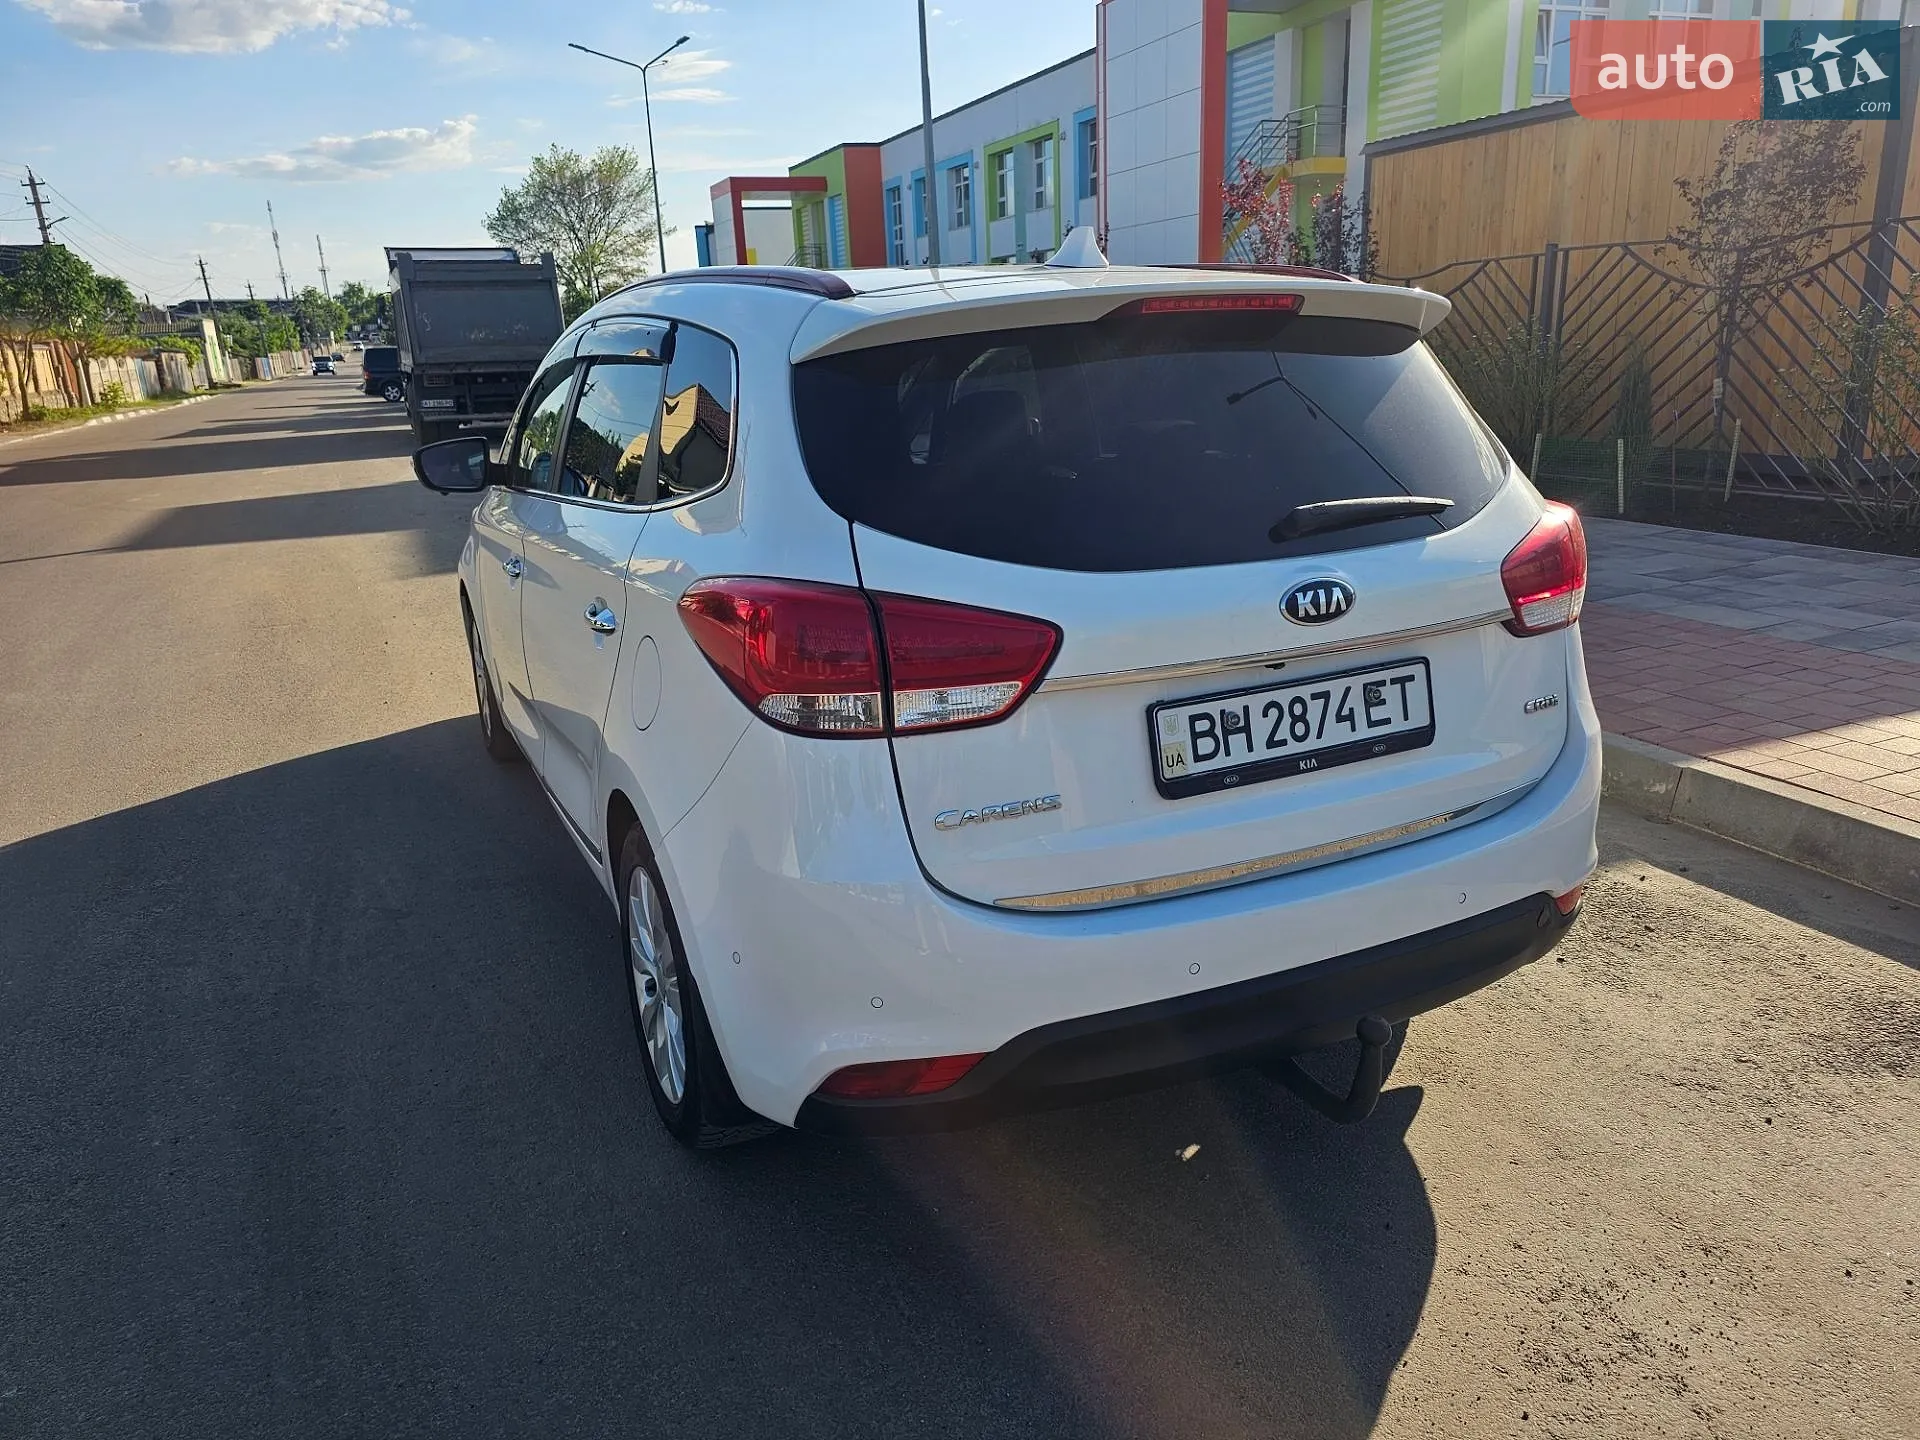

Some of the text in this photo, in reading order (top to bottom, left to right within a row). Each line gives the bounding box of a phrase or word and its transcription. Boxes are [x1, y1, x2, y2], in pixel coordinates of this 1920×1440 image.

[1295, 586, 1347, 618] KIA
[1166, 753, 1185, 768] UA
[1299, 758, 1319, 770] KIA
[934, 794, 1063, 831] CARENS
